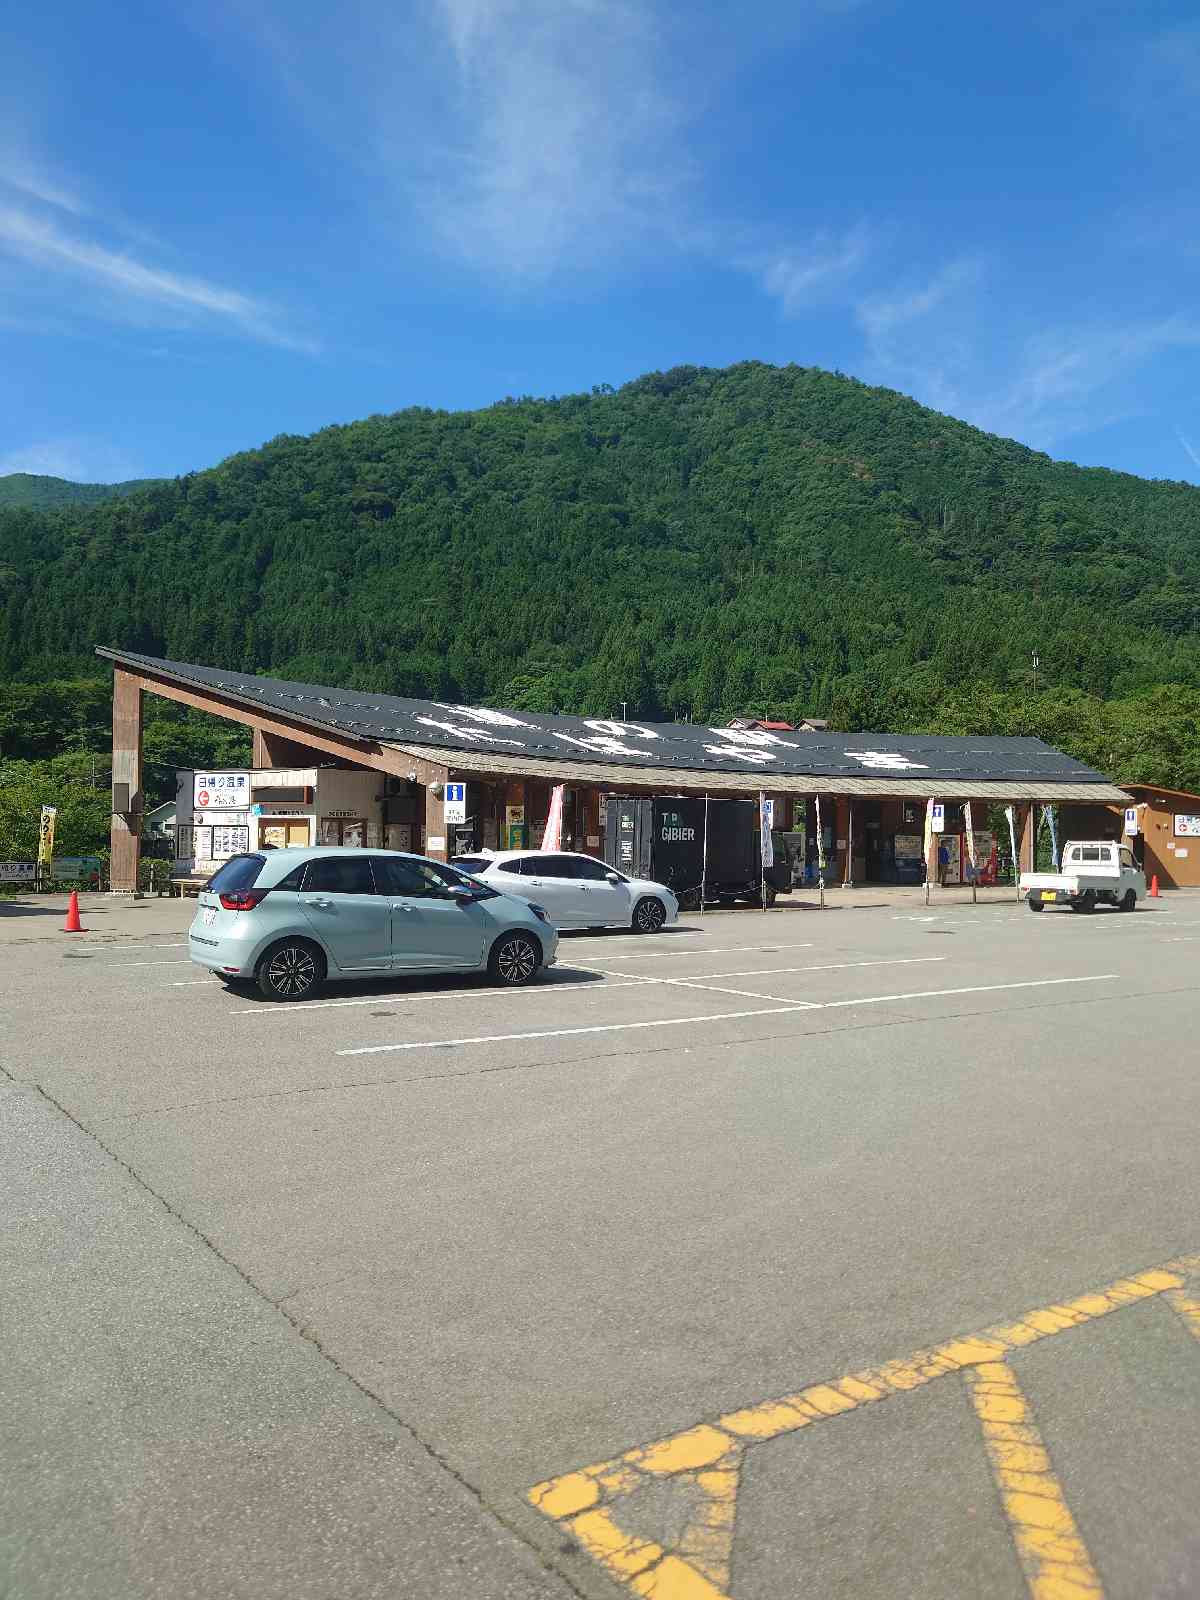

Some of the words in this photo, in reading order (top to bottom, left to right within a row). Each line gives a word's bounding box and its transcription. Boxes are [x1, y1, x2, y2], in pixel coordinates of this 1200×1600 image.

[199, 776, 245, 787] 日帰り温泉
[661, 827, 695, 841] GIBIER
